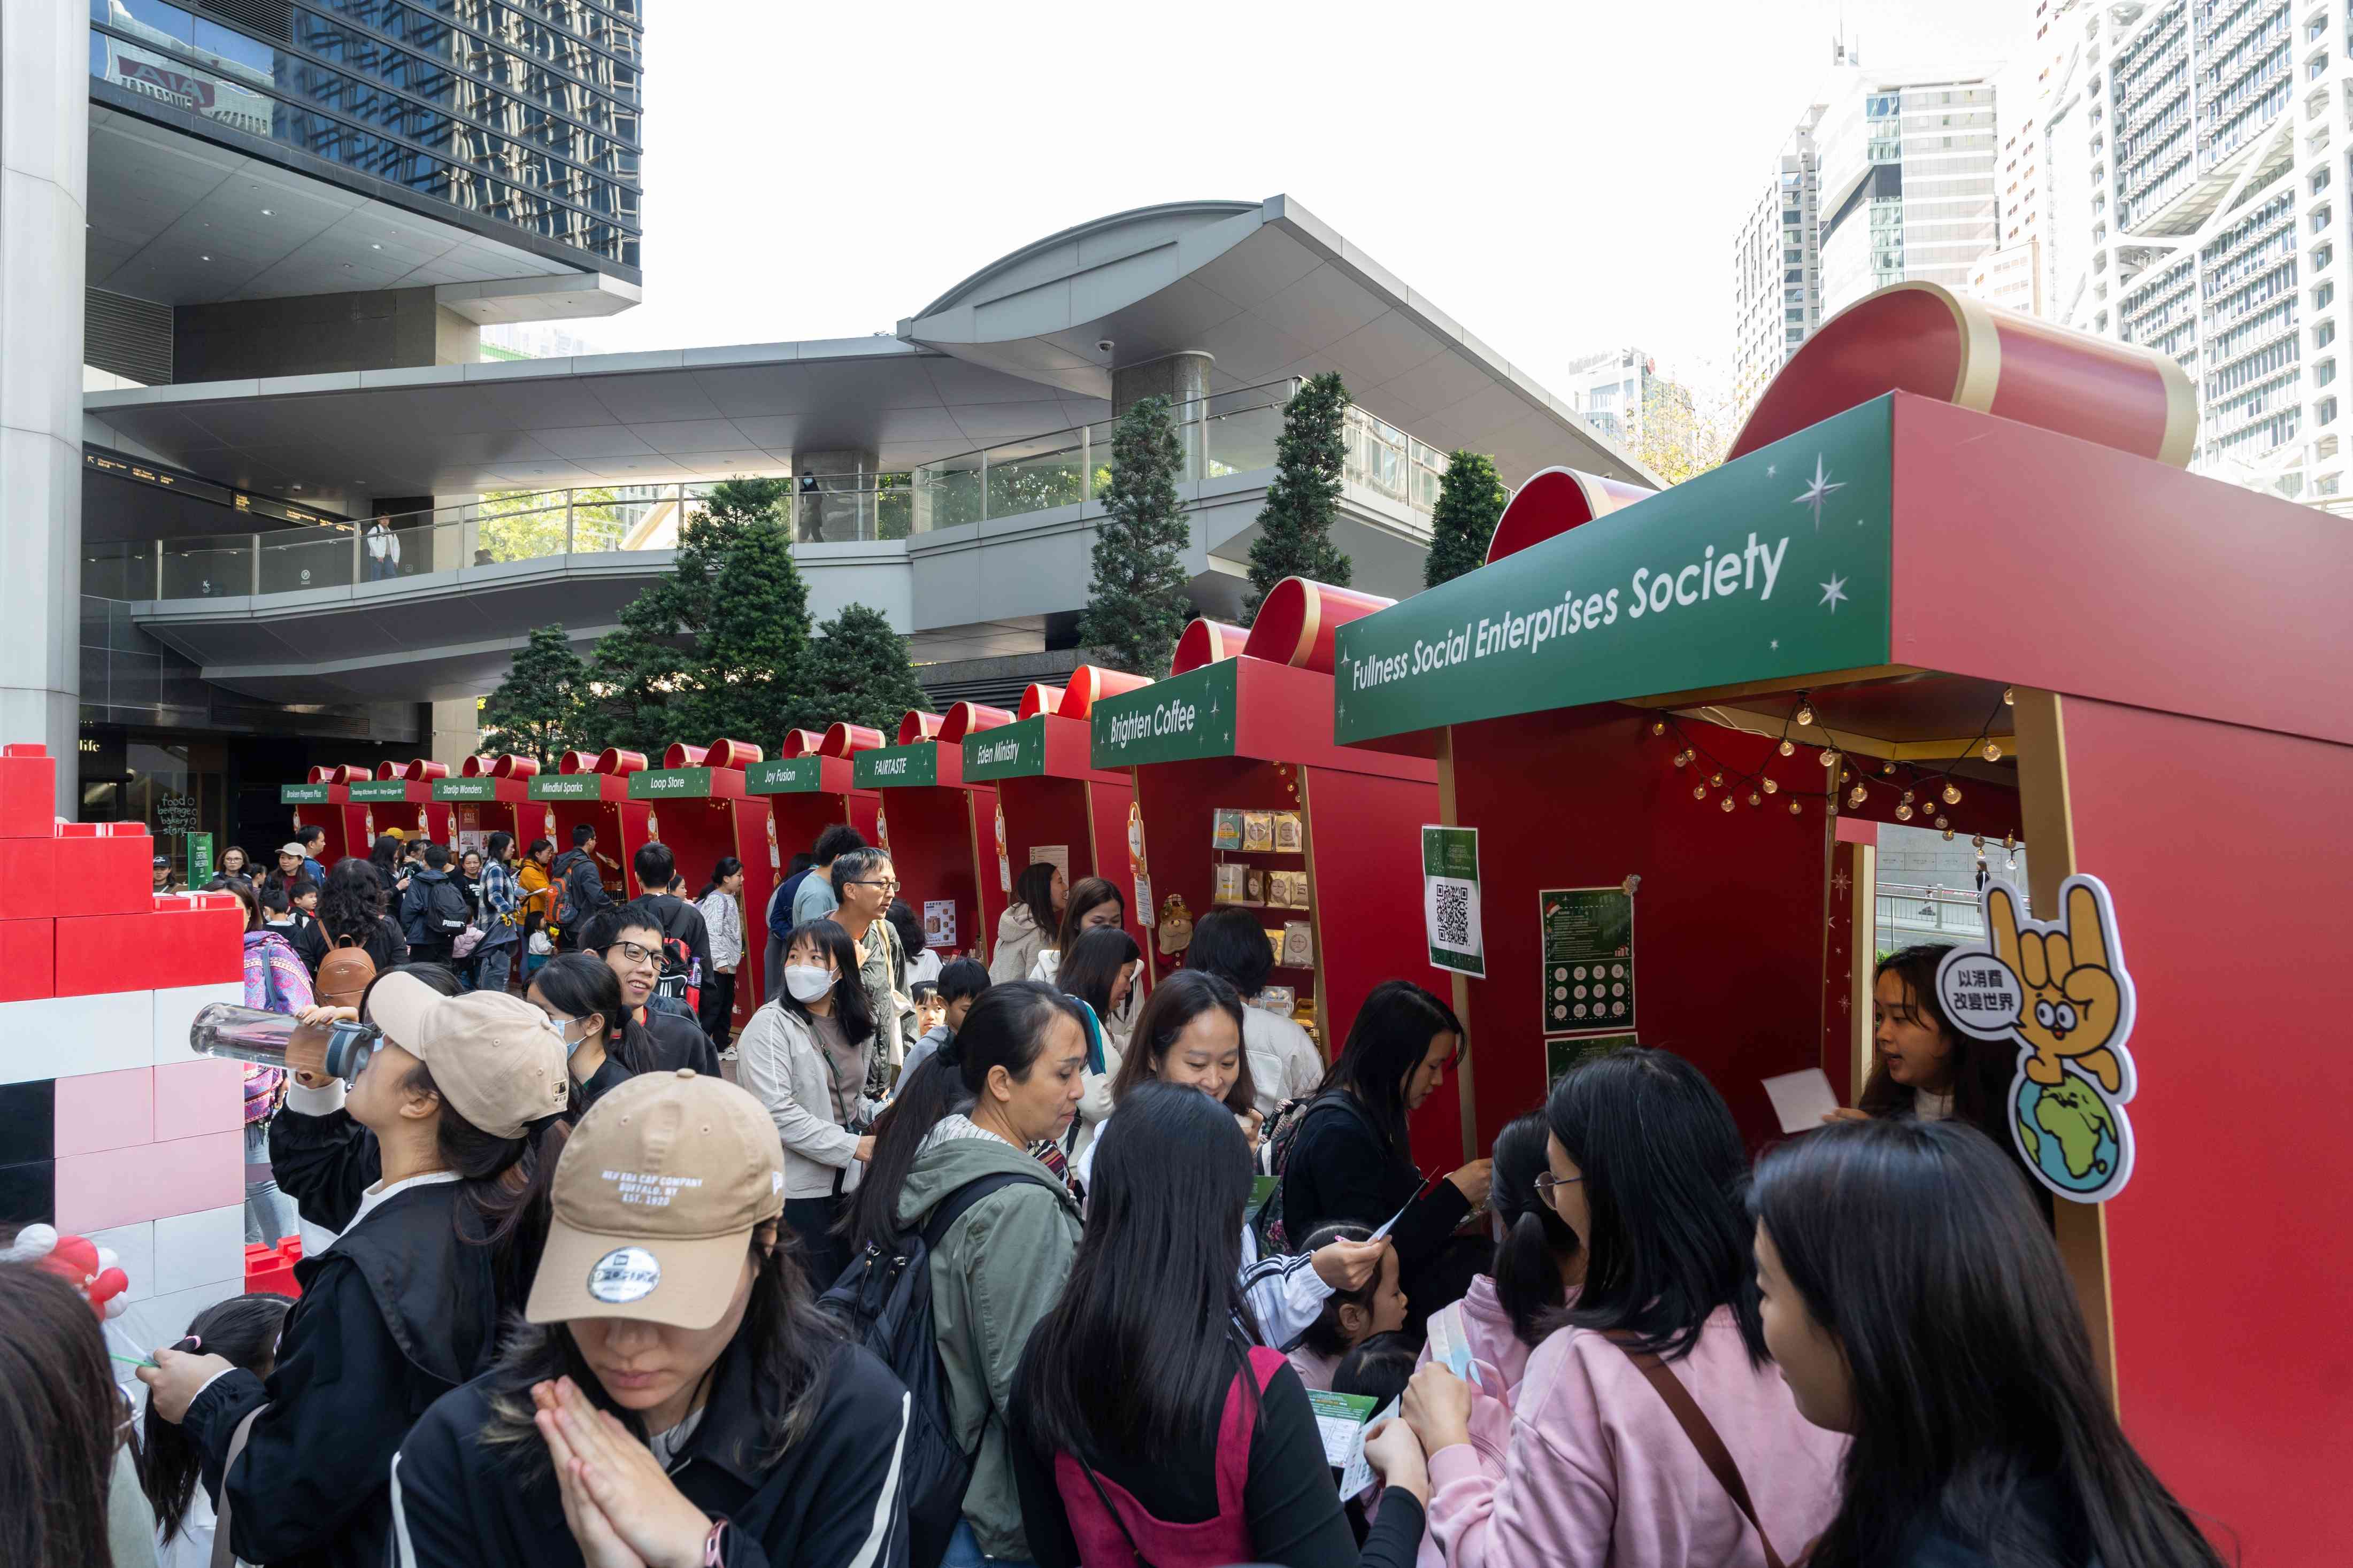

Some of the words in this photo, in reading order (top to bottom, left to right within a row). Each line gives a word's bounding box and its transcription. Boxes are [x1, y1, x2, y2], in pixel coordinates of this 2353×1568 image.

[1353, 652, 1409, 691] Fullness
[1412, 623, 1472, 675] Social
[1474, 588, 1620, 658] Enterprises
[1628, 532, 1789, 619] Society
[1111, 710, 1151, 749] Brighten
[1154, 699, 1196, 736] Coffee
[977, 744, 993, 764] Eden
[994, 739, 1020, 764] Ministry
[874, 758, 907, 776] FAIRTASTE
[765, 769, 776, 784] Joy
[776, 768, 796, 782] Fusion
[459, 784, 482, 794] Wonders
[542, 782, 563, 793] Mindful
[563, 782, 583, 794] Sparks
[650, 777, 666, 791] Loop
[668, 776, 685, 789] Store
[162, 792, 186, 806] food
[313, 790, 321, 798] Plus
[157, 804, 191, 817] beverage
[160, 815, 189, 827] bakery
[442, 919, 462, 928] PUMA
[1558, 970, 1563, 979] 1
[1596, 968, 1602, 976] 3
[1614, 967, 1620, 976] 4
[1958, 969, 2003, 988] 以消費
[1558, 989, 1563, 997] 5
[1578, 988, 1582, 996] 6
[1596, 987, 1602, 995] 7
[1616, 986, 1621, 994] 8
[1953, 992, 2014, 1011] 改變世界
[1575, 1007, 1585, 1015] 10
[1595, 1006, 1603, 1014] 11
[1614, 1004, 1623, 1013] 12
[602, 1170, 619, 1180] NEW
[620, 1172, 637, 1182] ERA
[639, 1173, 658, 1184] CAP
[659, 1176, 703, 1187] COMPANY
[665, 1187, 679, 1196] NY
[645, 1195, 671, 1207] 1920
